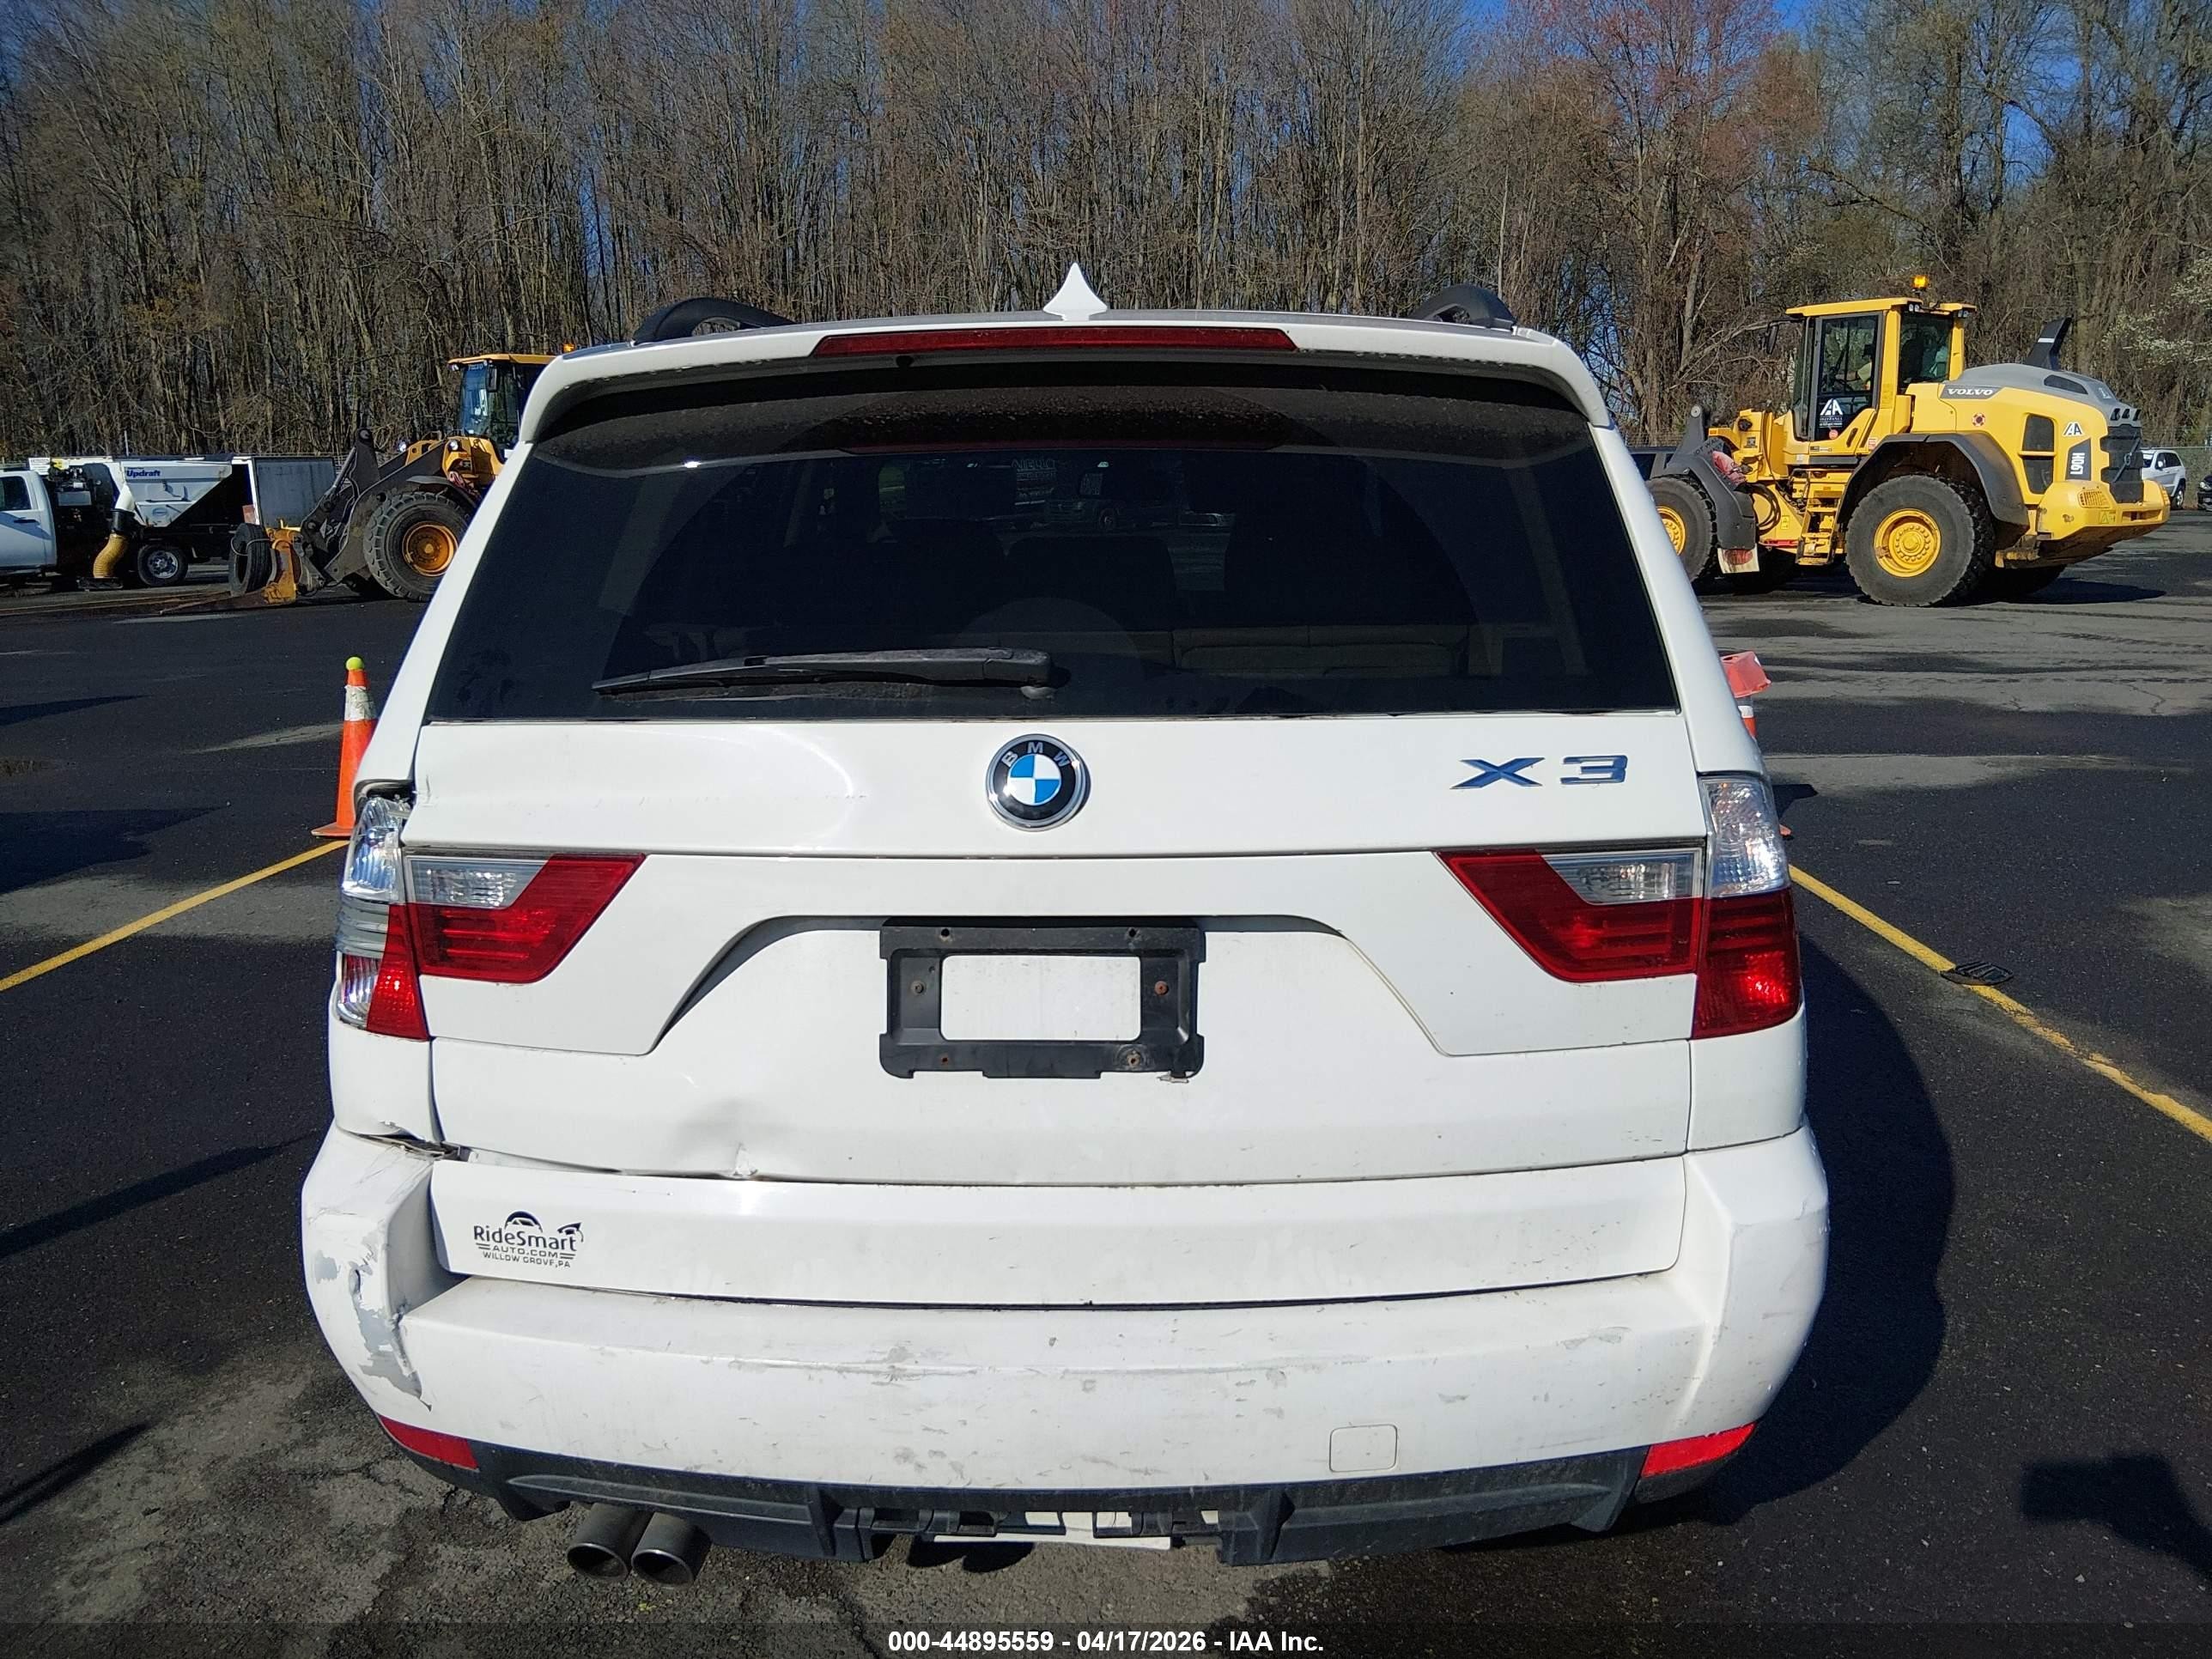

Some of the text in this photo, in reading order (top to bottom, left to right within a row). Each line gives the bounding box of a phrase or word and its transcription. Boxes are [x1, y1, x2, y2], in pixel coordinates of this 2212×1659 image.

[2069, 453, 2086, 475] L90H
[1001, 742, 1071, 767] BMW
[1449, 754, 1628, 789] X3
[473, 1224, 577, 1252] RideSmart
[483, 1251, 520, 1263] WILLOW
[493, 1244, 558, 1259] AUTO.COM
